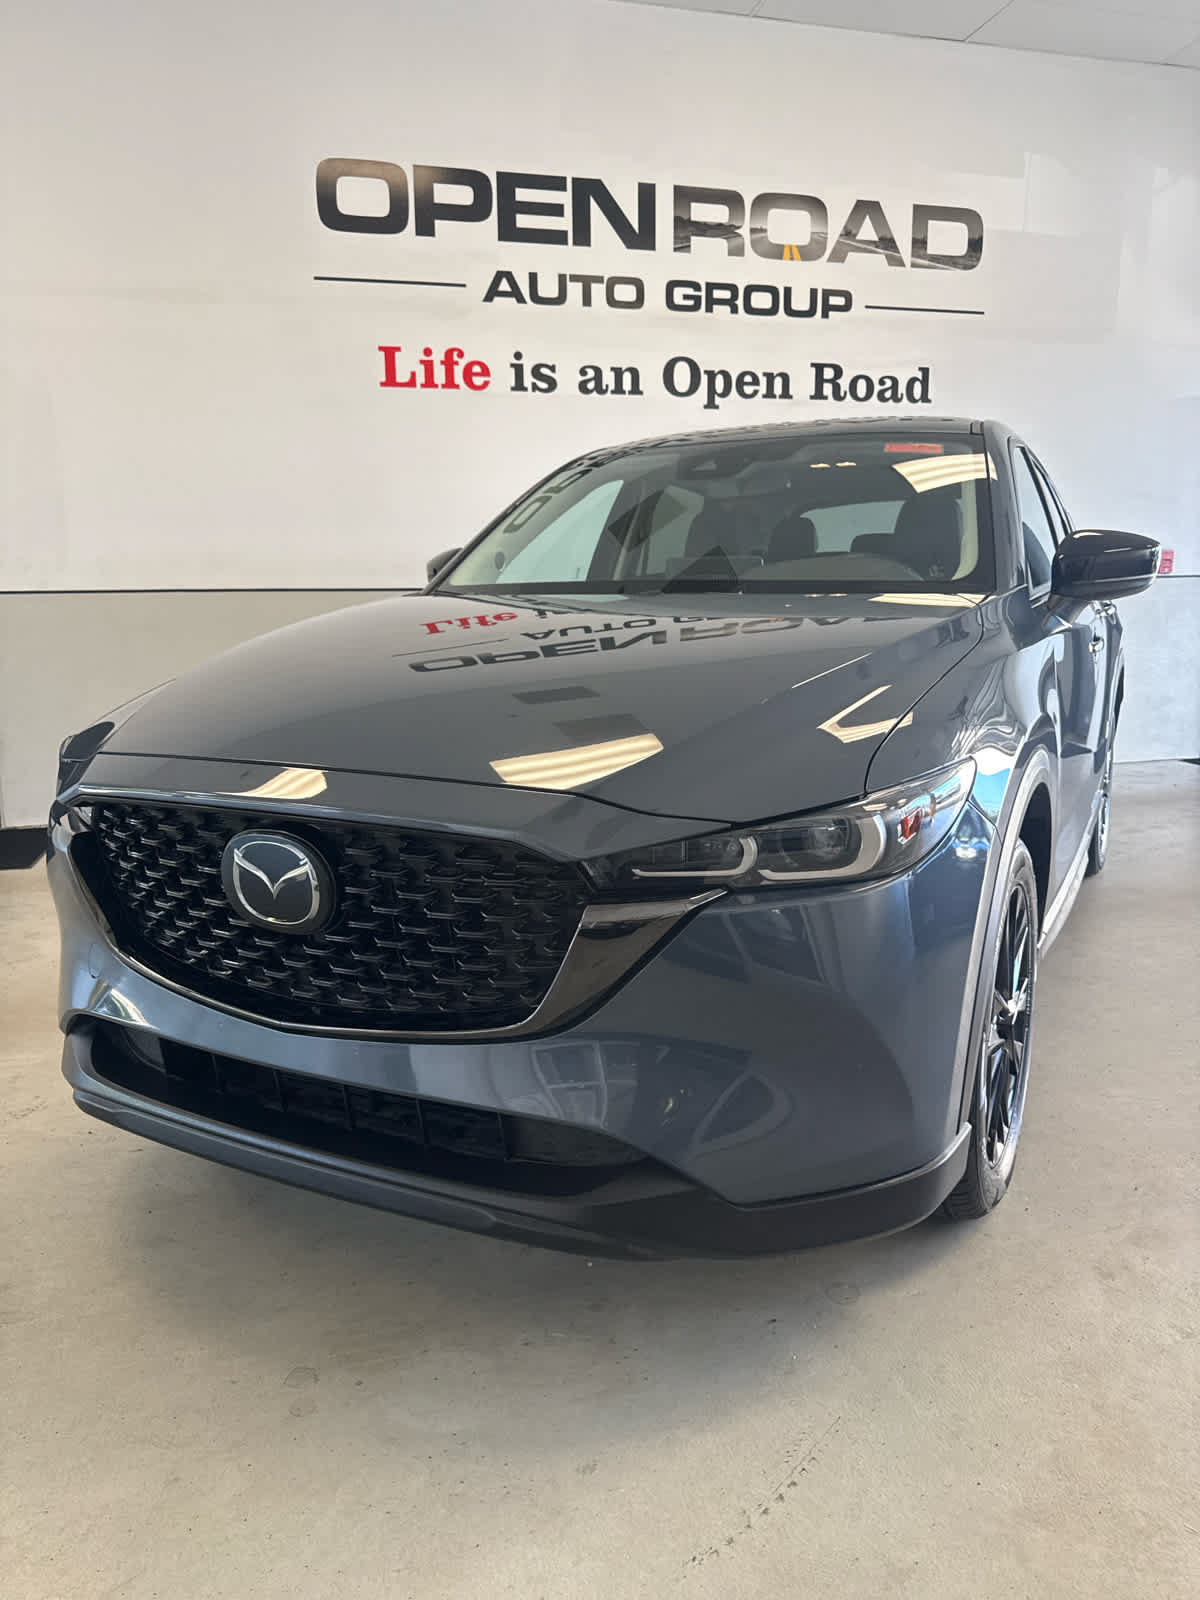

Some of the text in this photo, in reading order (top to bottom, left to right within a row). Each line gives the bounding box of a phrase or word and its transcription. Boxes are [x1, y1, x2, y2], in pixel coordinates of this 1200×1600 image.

[315, 157, 984, 271] OPEN ROAD
[482, 270, 853, 320] AUTO GROUP
[377, 345, 932, 410] Life is an Open Road
